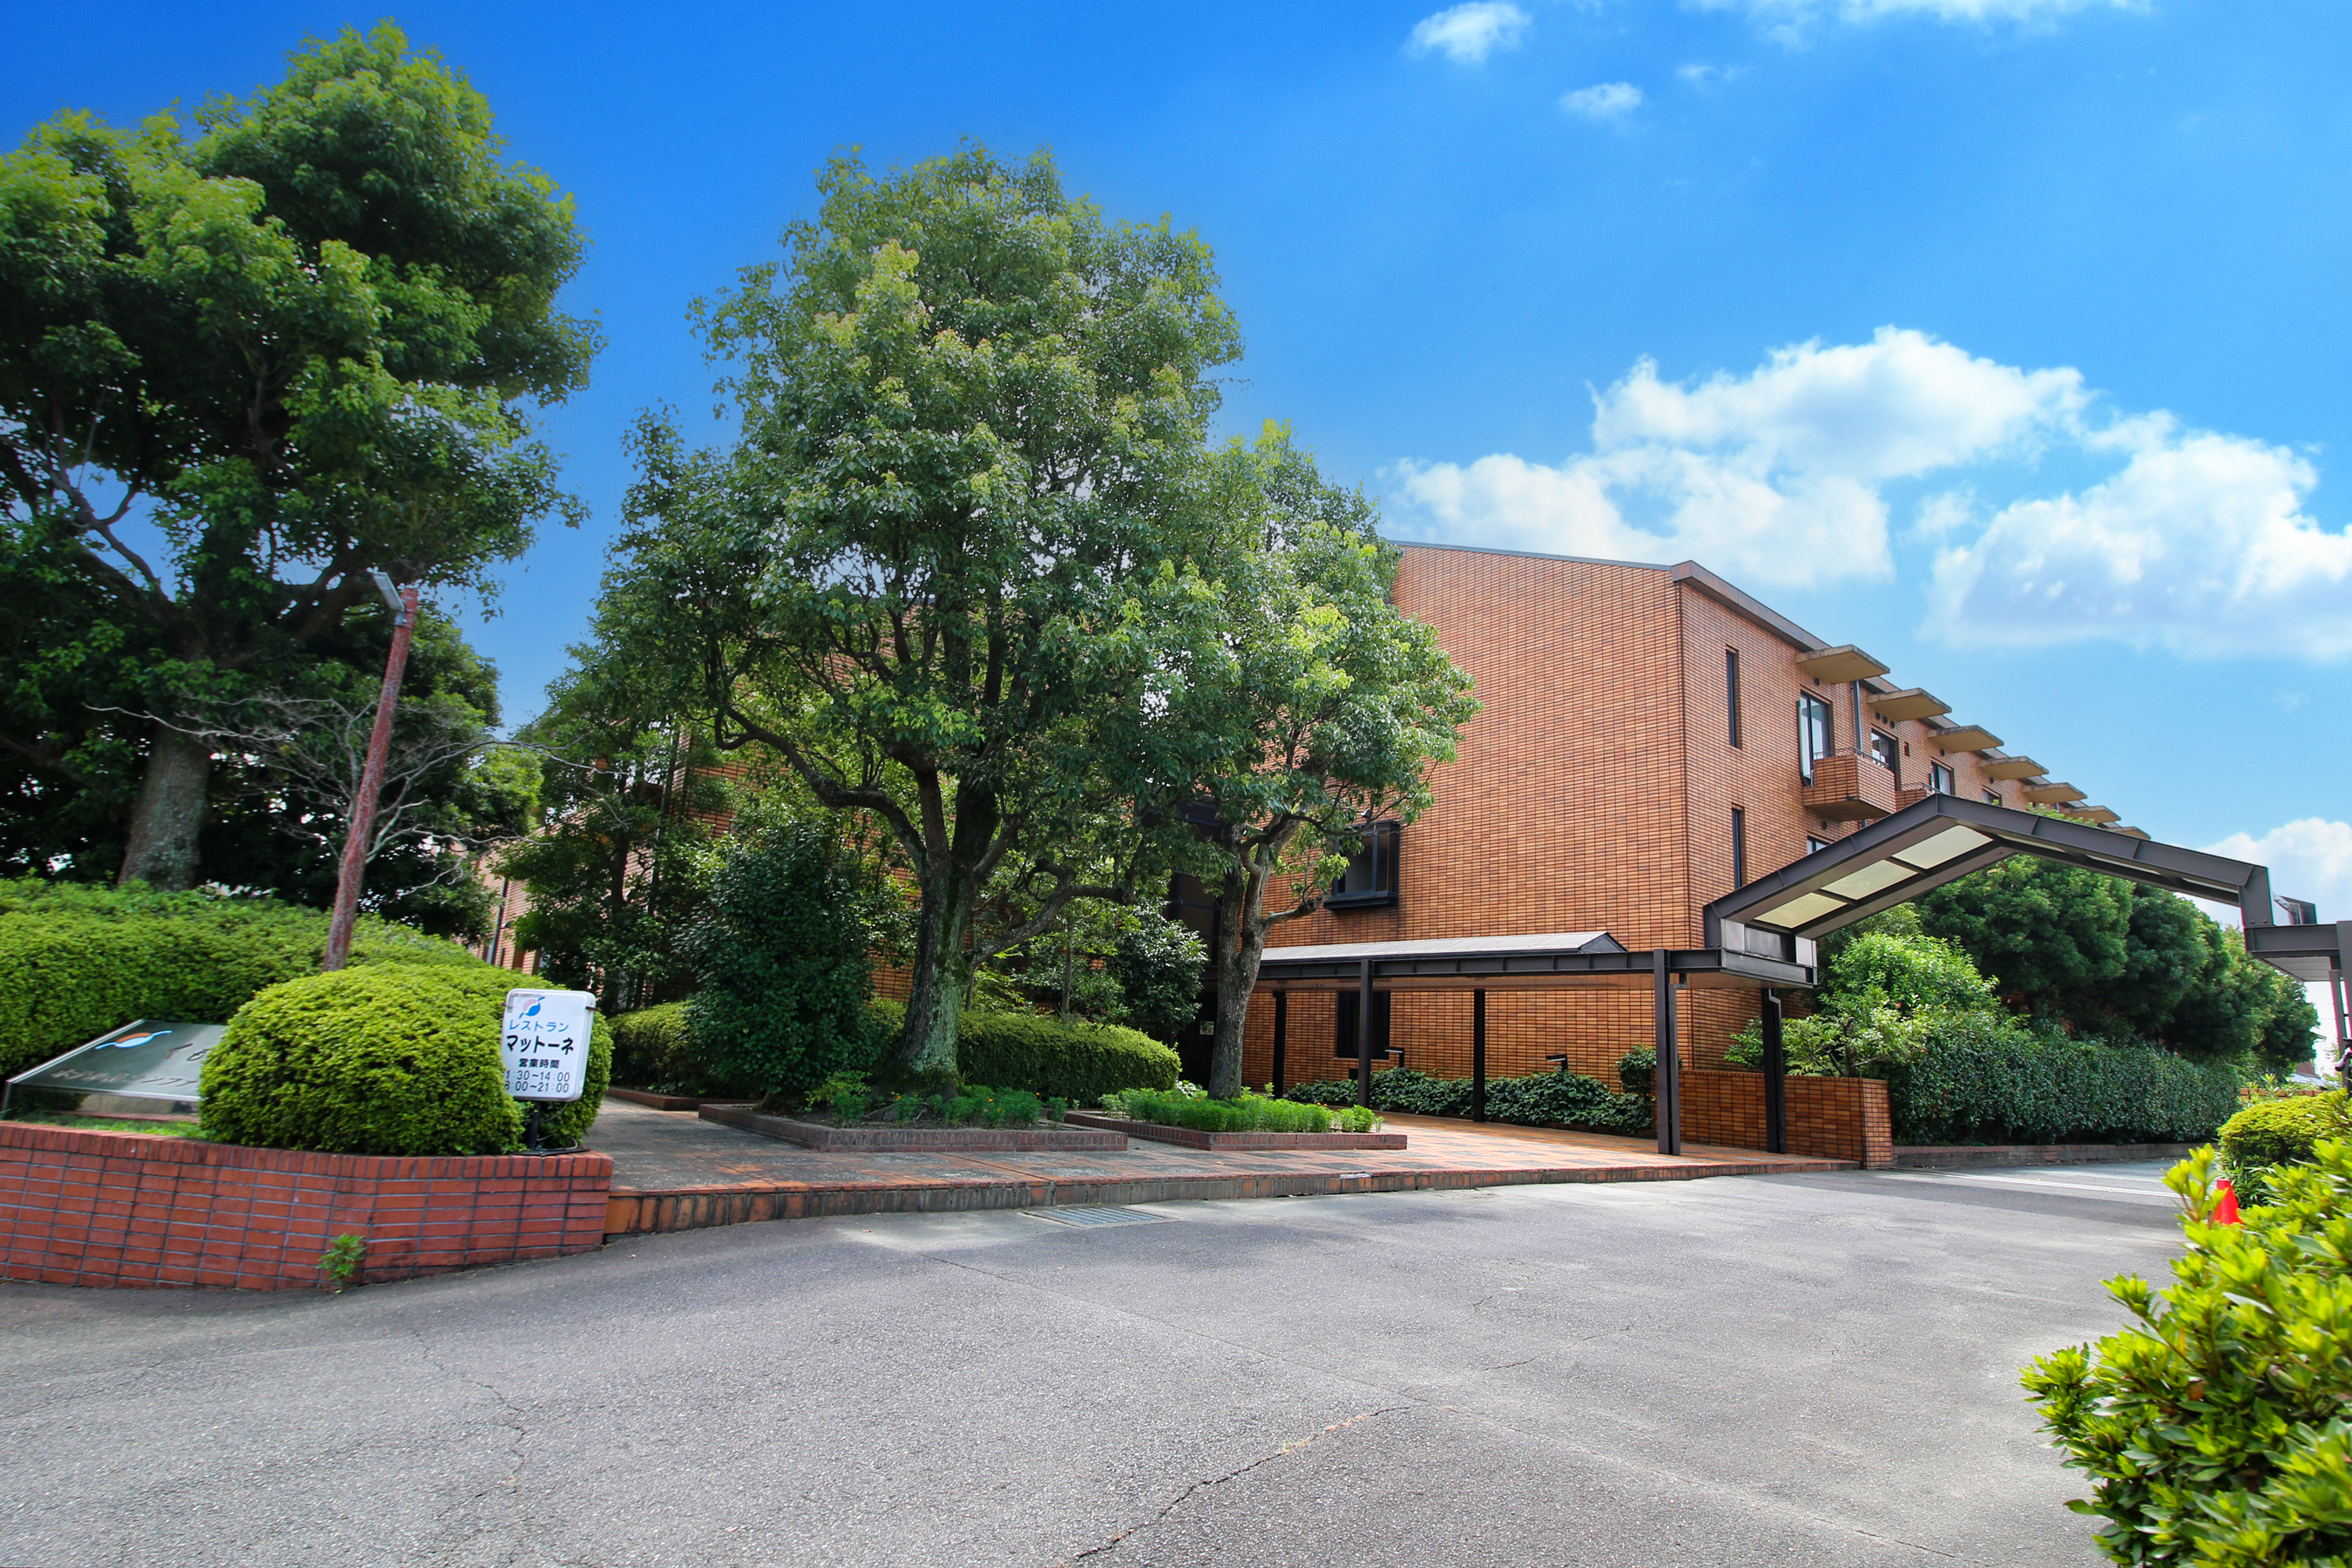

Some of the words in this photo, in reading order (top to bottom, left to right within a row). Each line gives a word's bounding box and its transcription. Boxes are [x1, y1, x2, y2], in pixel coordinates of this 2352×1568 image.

[510, 1019, 569, 1032] レストラン
[507, 1035, 574, 1055] マットーネ
[518, 1058, 560, 1069] 営業時間
[505, 1070, 571, 1082] 1:30~14:00
